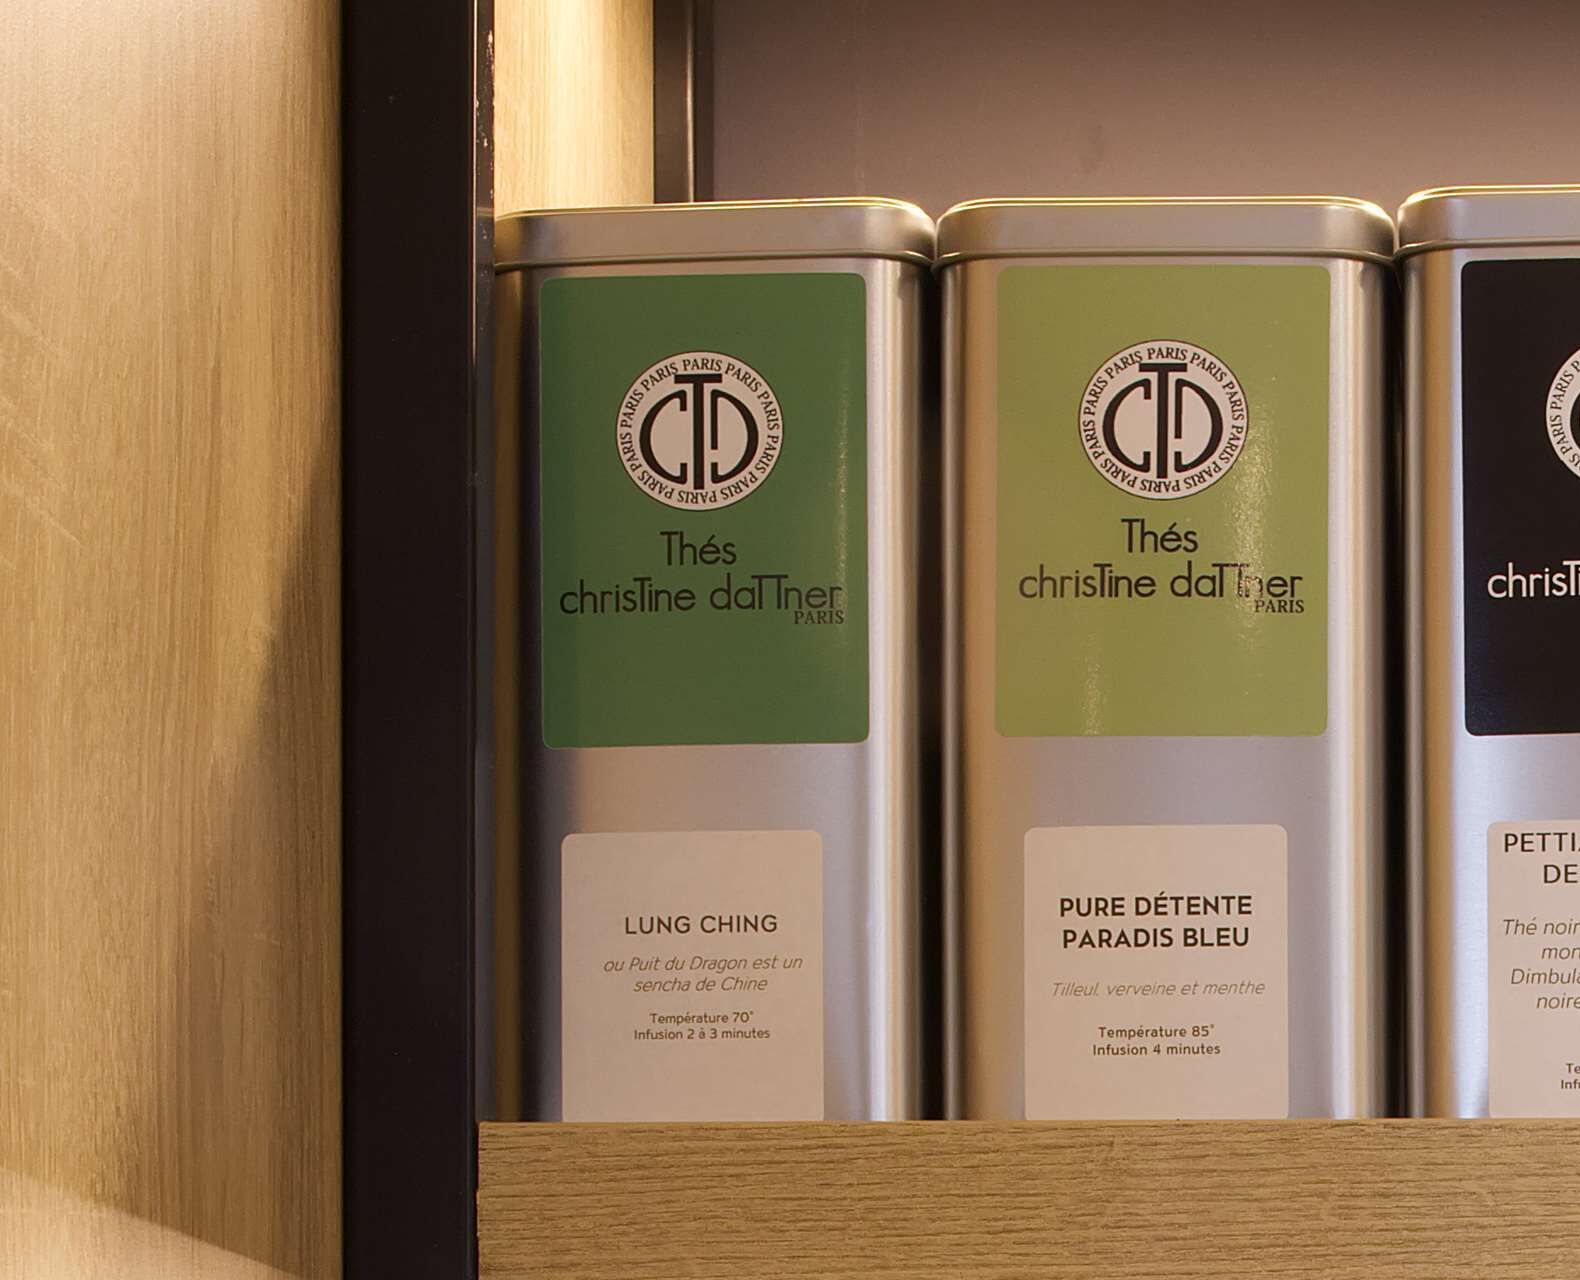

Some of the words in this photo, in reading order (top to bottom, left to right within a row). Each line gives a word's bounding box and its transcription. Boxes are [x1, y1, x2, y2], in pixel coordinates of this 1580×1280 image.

[682, 357, 723, 372] PARIS
[1104, 350, 1143, 380] PARIS
[1147, 346, 1188, 362] PARIS
[1189, 352, 1228, 383] PARIS
[640, 362, 679, 392] PARIS
[724, 362, 762, 393] PARIS
[1549, 370, 1574, 410] PARIS
[619, 388, 644, 429] PARIS
[756, 390, 780, 431] PARIS
[1083, 376, 1109, 416] PARIS
[1221, 380, 1245, 421] PARIS
[1082, 419, 1106, 460] PARIS
[1218, 424, 1244, 464] PARIS
[1549, 414, 1573, 455] PARIS
[619, 432, 643, 473] PARIS
[754, 434, 780, 474] PARIS
[637, 470, 675, 500] PARIS
[719, 471, 759, 501] PARIS
[1100, 458, 1138, 488] PARIS
[1139, 478, 1181, 494] PARIS
[1183, 460, 1223, 490] PARIS
[677, 490, 718, 505] PARIS
[659, 530, 737, 567] Thés
[1120, 518, 1199, 554] Thés
[793, 610, 844, 624] PARIS
[1255, 598, 1304, 614] PARIS
[1543, 863, 1578, 884] DE
[1060, 896, 1126, 918] PURE
[1134, 890, 1252, 917] DÉTENTE
[625, 915, 691, 935] LUNG
[700, 914, 778, 934] CHING
[1063, 927, 1174, 949] PARADIS
[1183, 927, 1249, 948] BLEU
[1502, 916, 1538, 936] Thé
[1543, 918, 1580, 936] noir
[603, 960, 625, 973] ou
[628, 956, 661, 972] Puit
[664, 956, 686, 971] du
[688, 955, 748, 975] Dragon
[751, 954, 780, 970] est
[782, 957, 804, 969] un
[633, 977, 692, 993] sencha
[695, 976, 717, 992] de
[720, 976, 769, 992] Chine
[1106, 982, 1177, 997] verveine
[1181, 981, 1200, 996] et
[1202, 980, 1266, 996] menthe
[634, 1028, 684, 1040] Infusion
[686, 1027, 695, 1040] 2
[698, 1026, 706, 1040] à
[709, 1027, 718, 1040] 3
[721, 1027, 771, 1039] minutes
[648, 1011, 729, 1027] Température
[1098, 1024, 1187, 1041] Température
[1092, 1043, 1148, 1056] Infusion
[1152, 1043, 1161, 1055] 4
[1166, 1042, 1221, 1055] minutes
